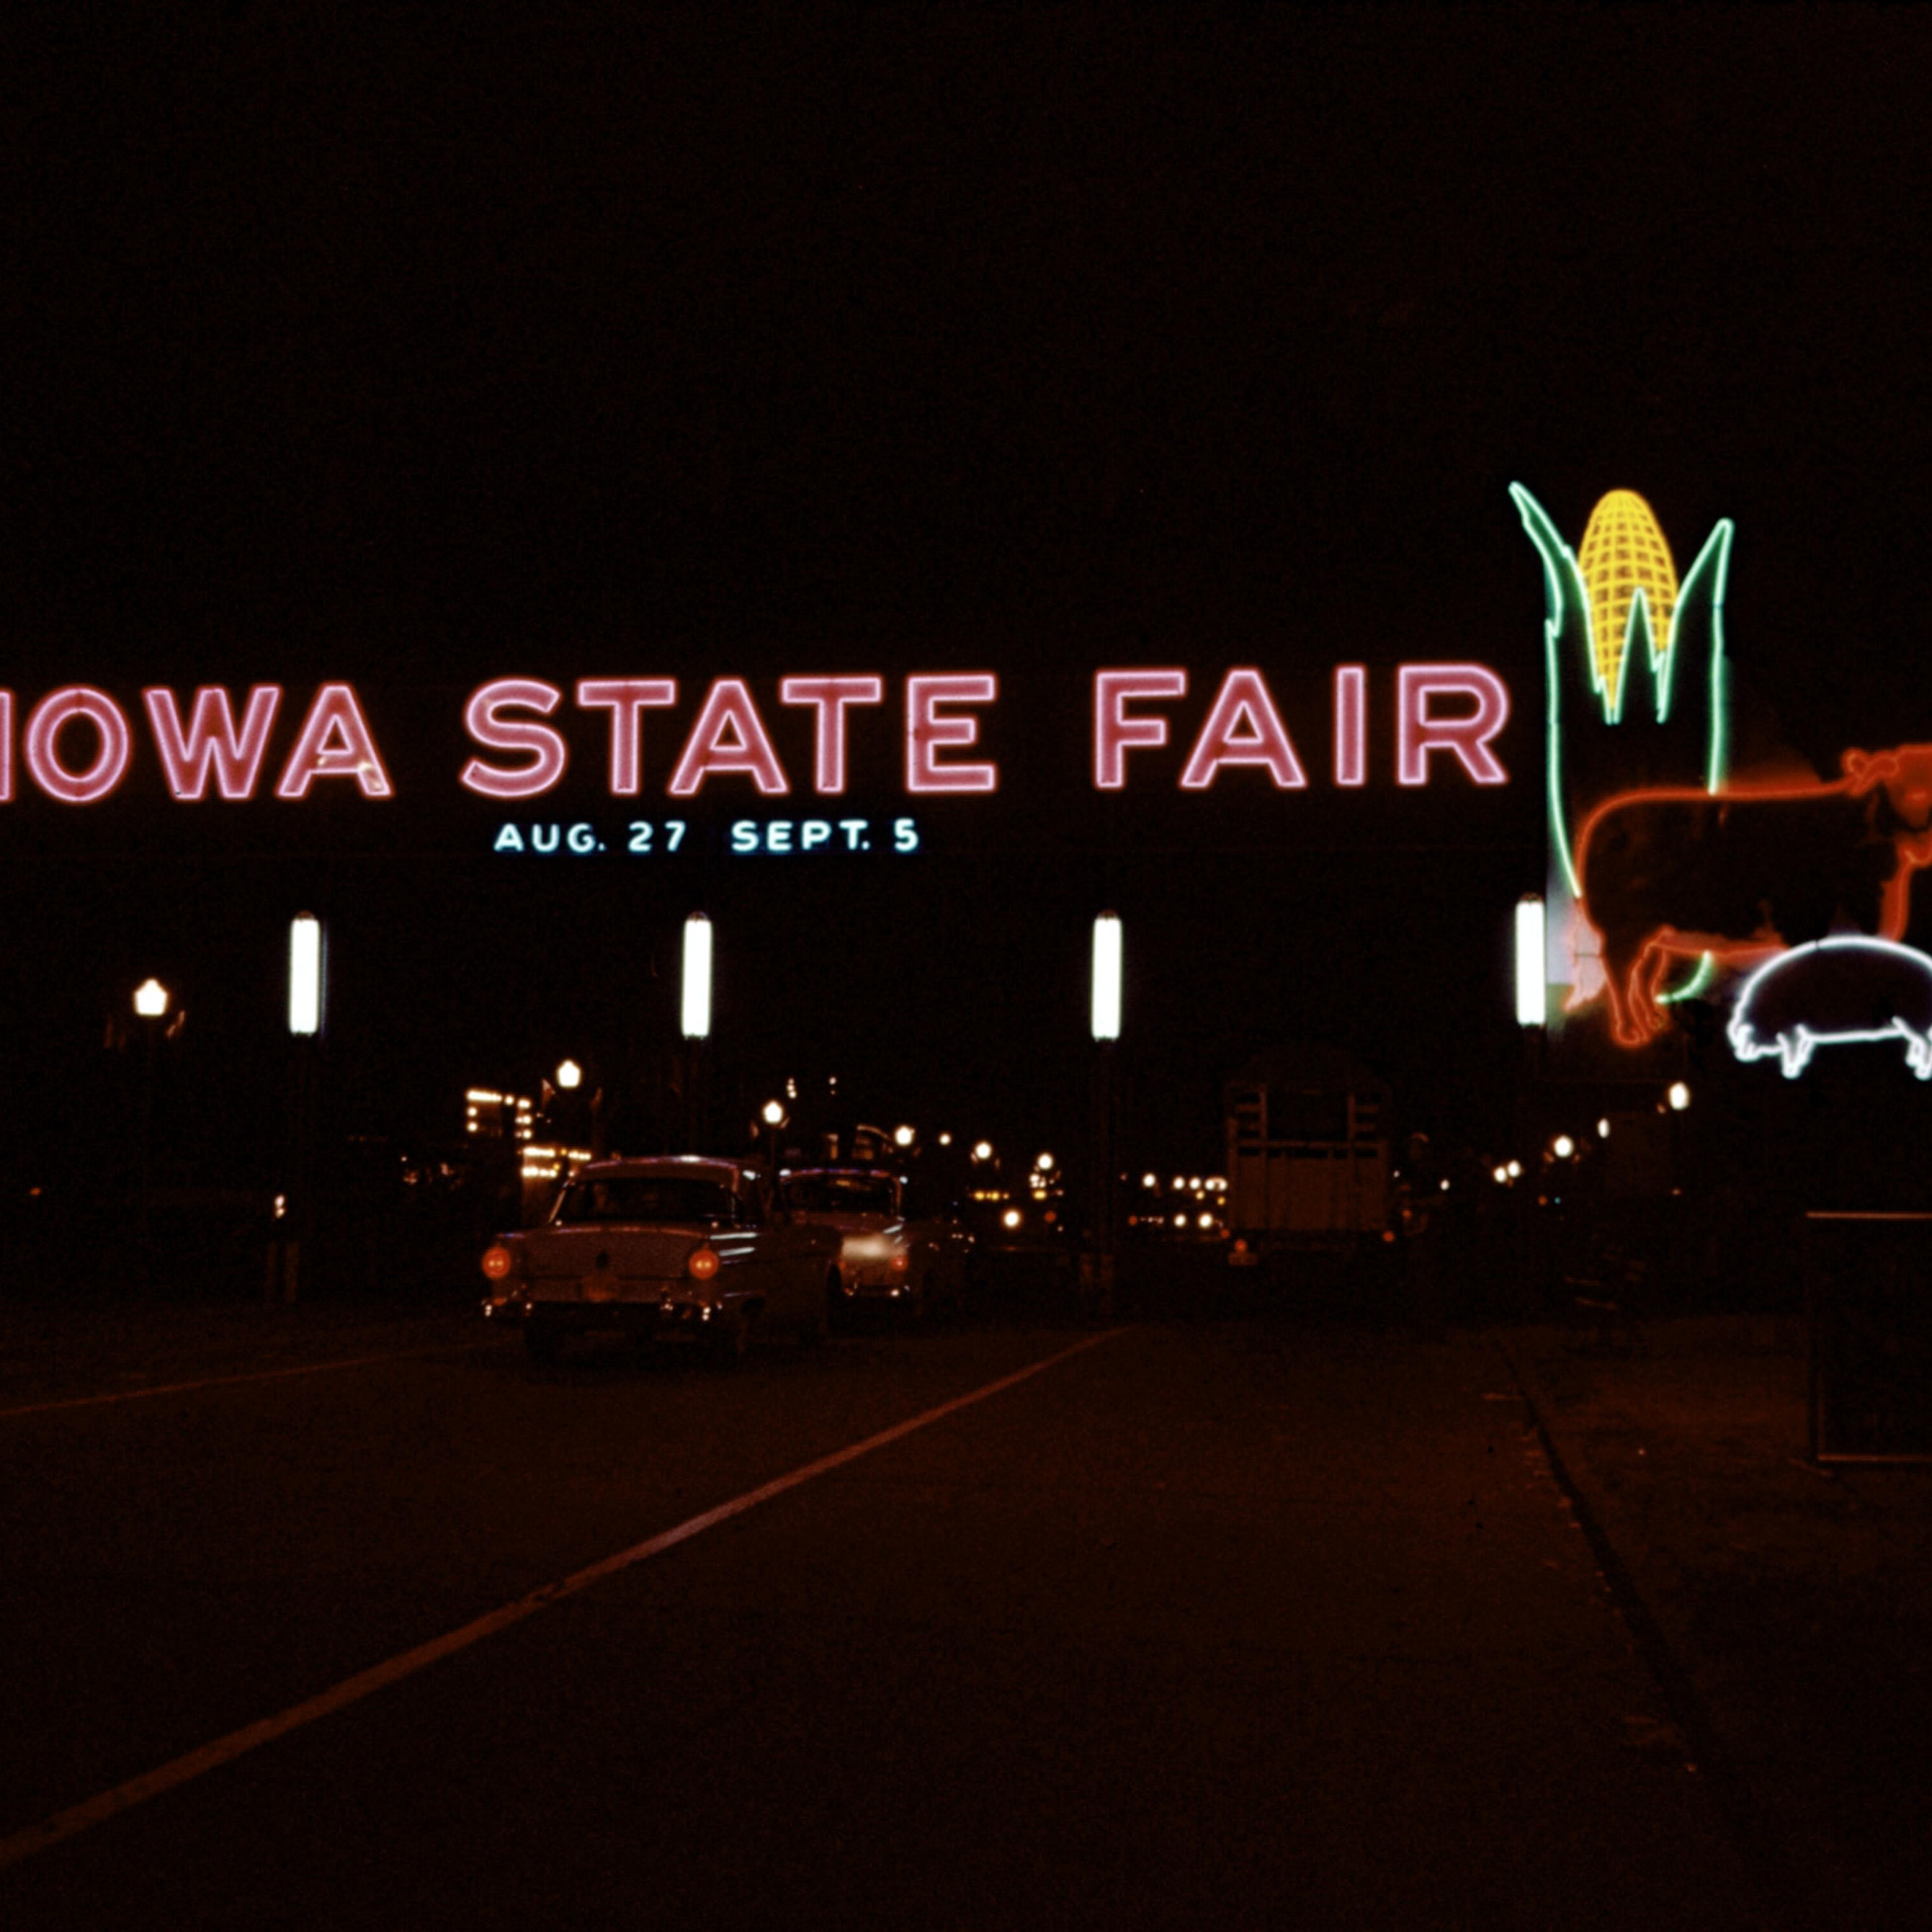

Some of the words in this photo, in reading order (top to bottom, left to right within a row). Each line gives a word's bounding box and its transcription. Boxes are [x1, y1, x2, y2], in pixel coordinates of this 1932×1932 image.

[459, 672, 998, 799] STATE
[1093, 662, 1510, 790] FAIR
[494, 823, 606, 854] AUG.
[628, 821, 686, 853] 27
[731, 819, 870, 854] SEPT.
[894, 818, 919, 852] 5
